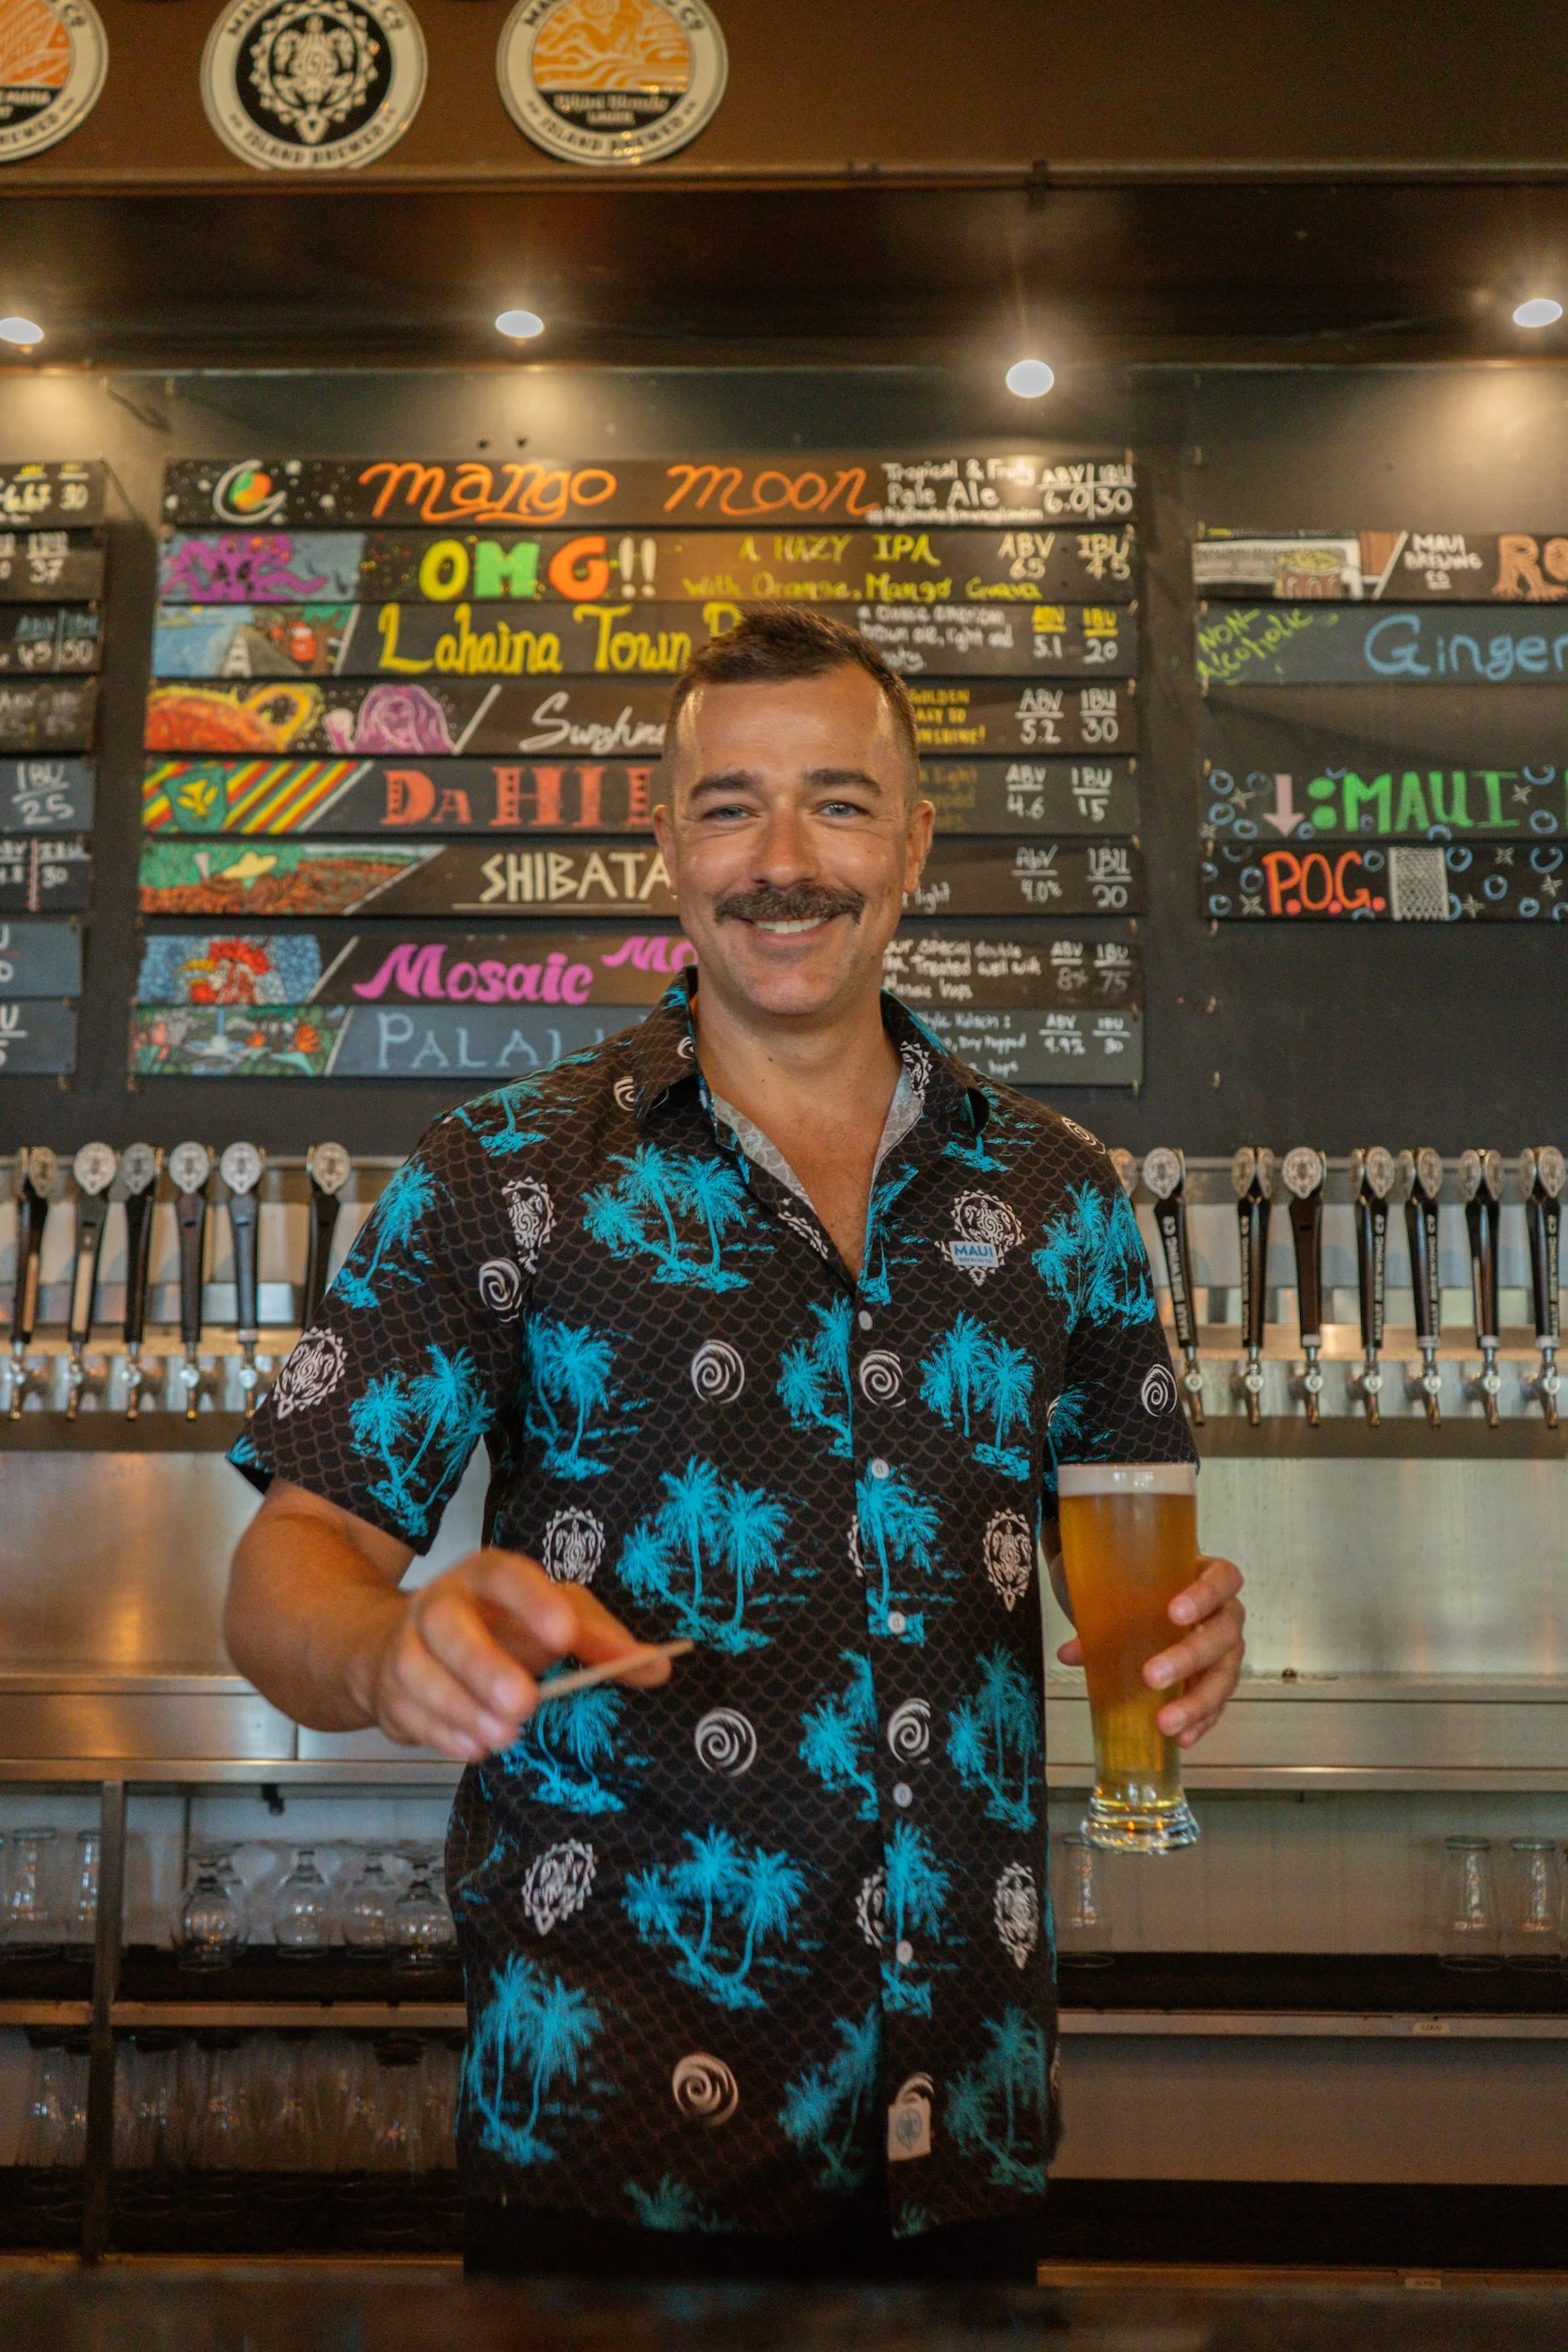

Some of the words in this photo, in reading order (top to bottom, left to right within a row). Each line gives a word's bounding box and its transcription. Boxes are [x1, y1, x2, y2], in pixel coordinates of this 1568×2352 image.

[887, 481, 938, 506] Pale
[947, 479, 1000, 508] Ale
[1043, 486, 1089, 515] 6.0
[1094, 487, 1133, 516] 30
[871, 532, 941, 566] IPA
[997, 532, 1055, 560] ABV
[1076, 533, 1131, 560] IBU
[1413, 532, 1465, 553] MAUI
[420, 535, 657, 602] OMG!!
[1404, 550, 1484, 571] BREWING
[864, 571, 953, 604] Mango
[965, 576, 1043, 601] Guava
[378, 601, 564, 675] Lahaina
[573, 603, 692, 672] Town
[1033, 635, 1063, 660] 5.1
[1084, 638, 1118, 664] 20
[1019, 688, 1065, 711] ABV
[1081, 689, 1117, 710] IBU
[916, 707, 943, 724] ASY
[1020, 718, 1062, 745] 5.2
[1082, 717, 1119, 744] 30
[1006, 763, 1047, 784] ABV
[1070, 766, 1114, 789] IBU
[1006, 794, 1047, 820] 4.6
[1077, 796, 1110, 823] 15
[1091, 883, 1129, 910] 20
[1050, 941, 1084, 958] ABV
[1096, 943, 1130, 960] IBU
[352, 943, 594, 1006] Mosaic
[976, 958, 1009, 977] well
[1010, 955, 1042, 976] with
[1099, 969, 1132, 994] 75
[1045, 1012, 1077, 1030] ABV
[1098, 1016, 1125, 1031] IBU
[954, 1244, 994, 1258] MAUI
